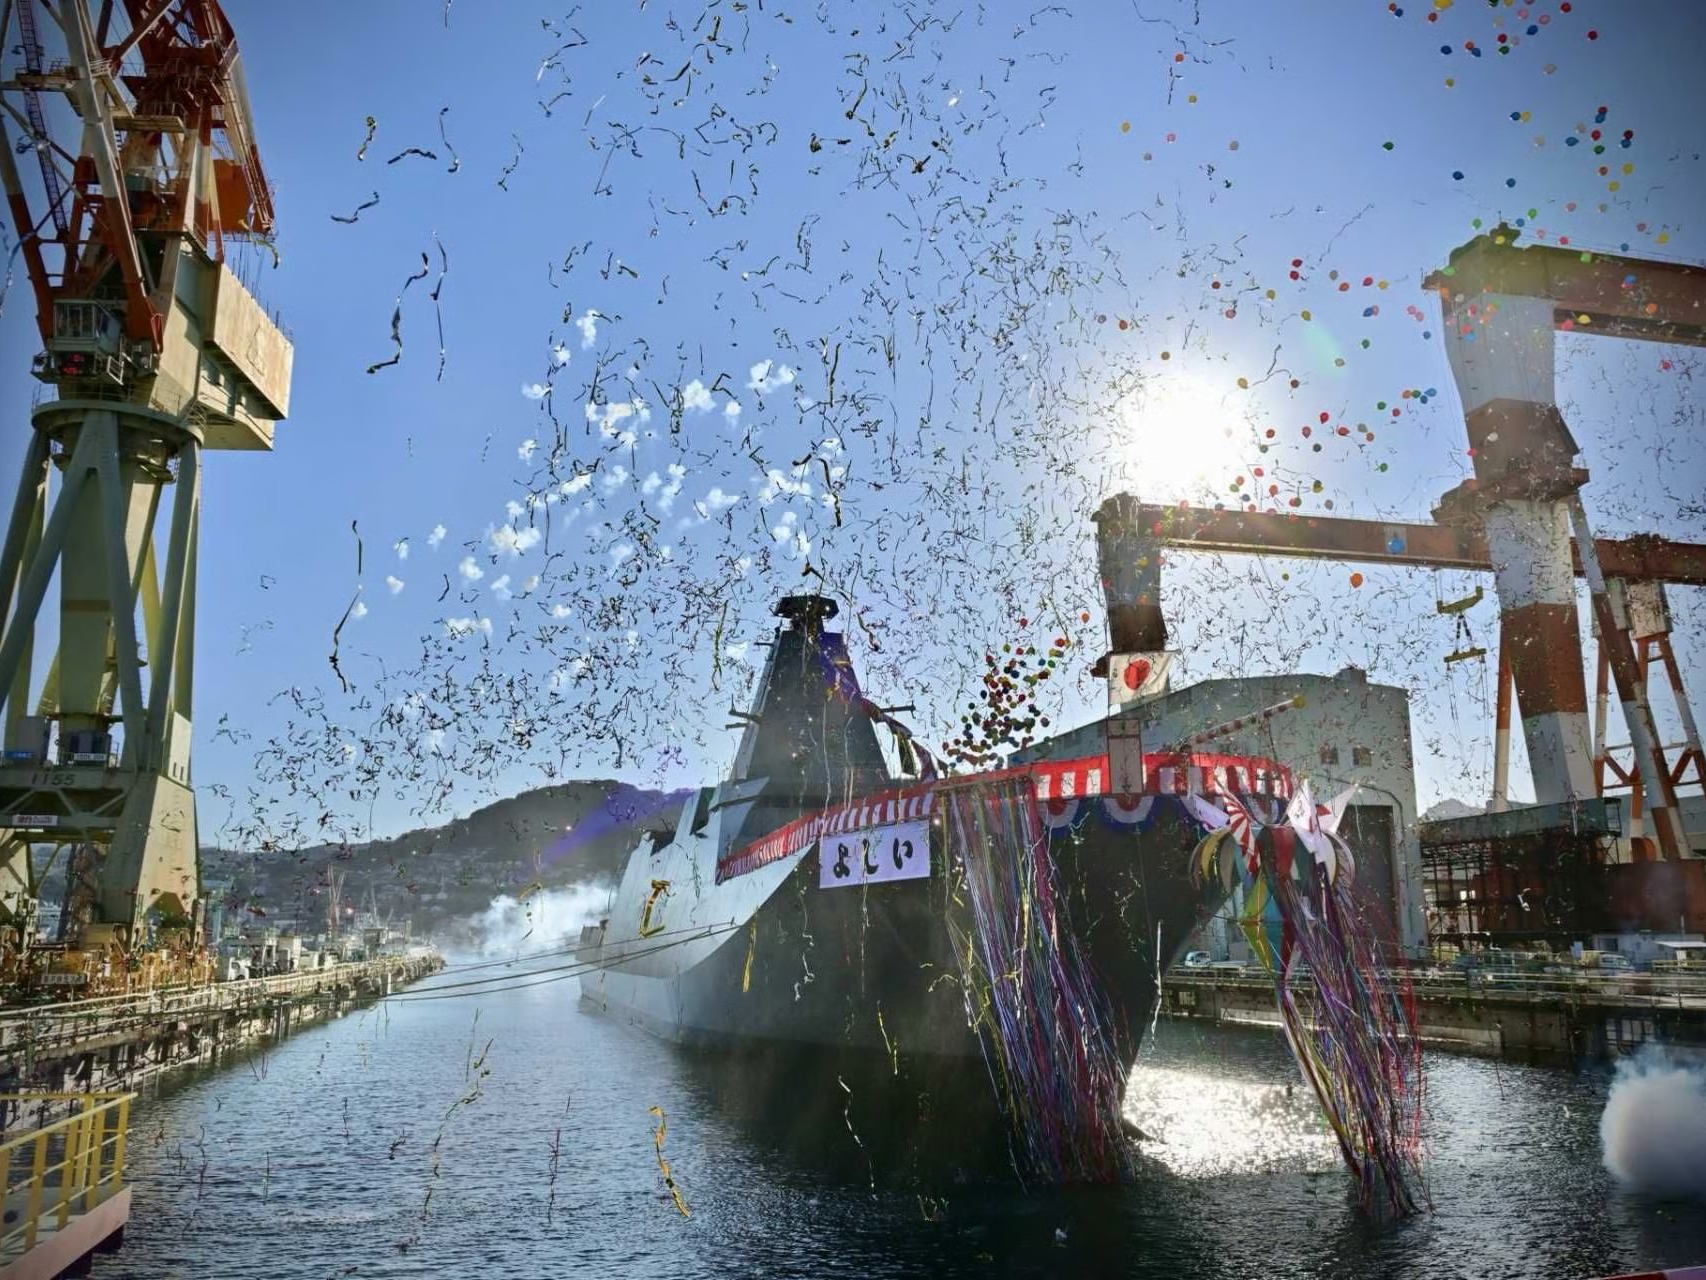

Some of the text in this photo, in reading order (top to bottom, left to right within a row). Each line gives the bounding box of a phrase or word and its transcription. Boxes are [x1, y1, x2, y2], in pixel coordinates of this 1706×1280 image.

[31, 772, 76, 786] 1155
[833, 837, 914, 879] よしい
